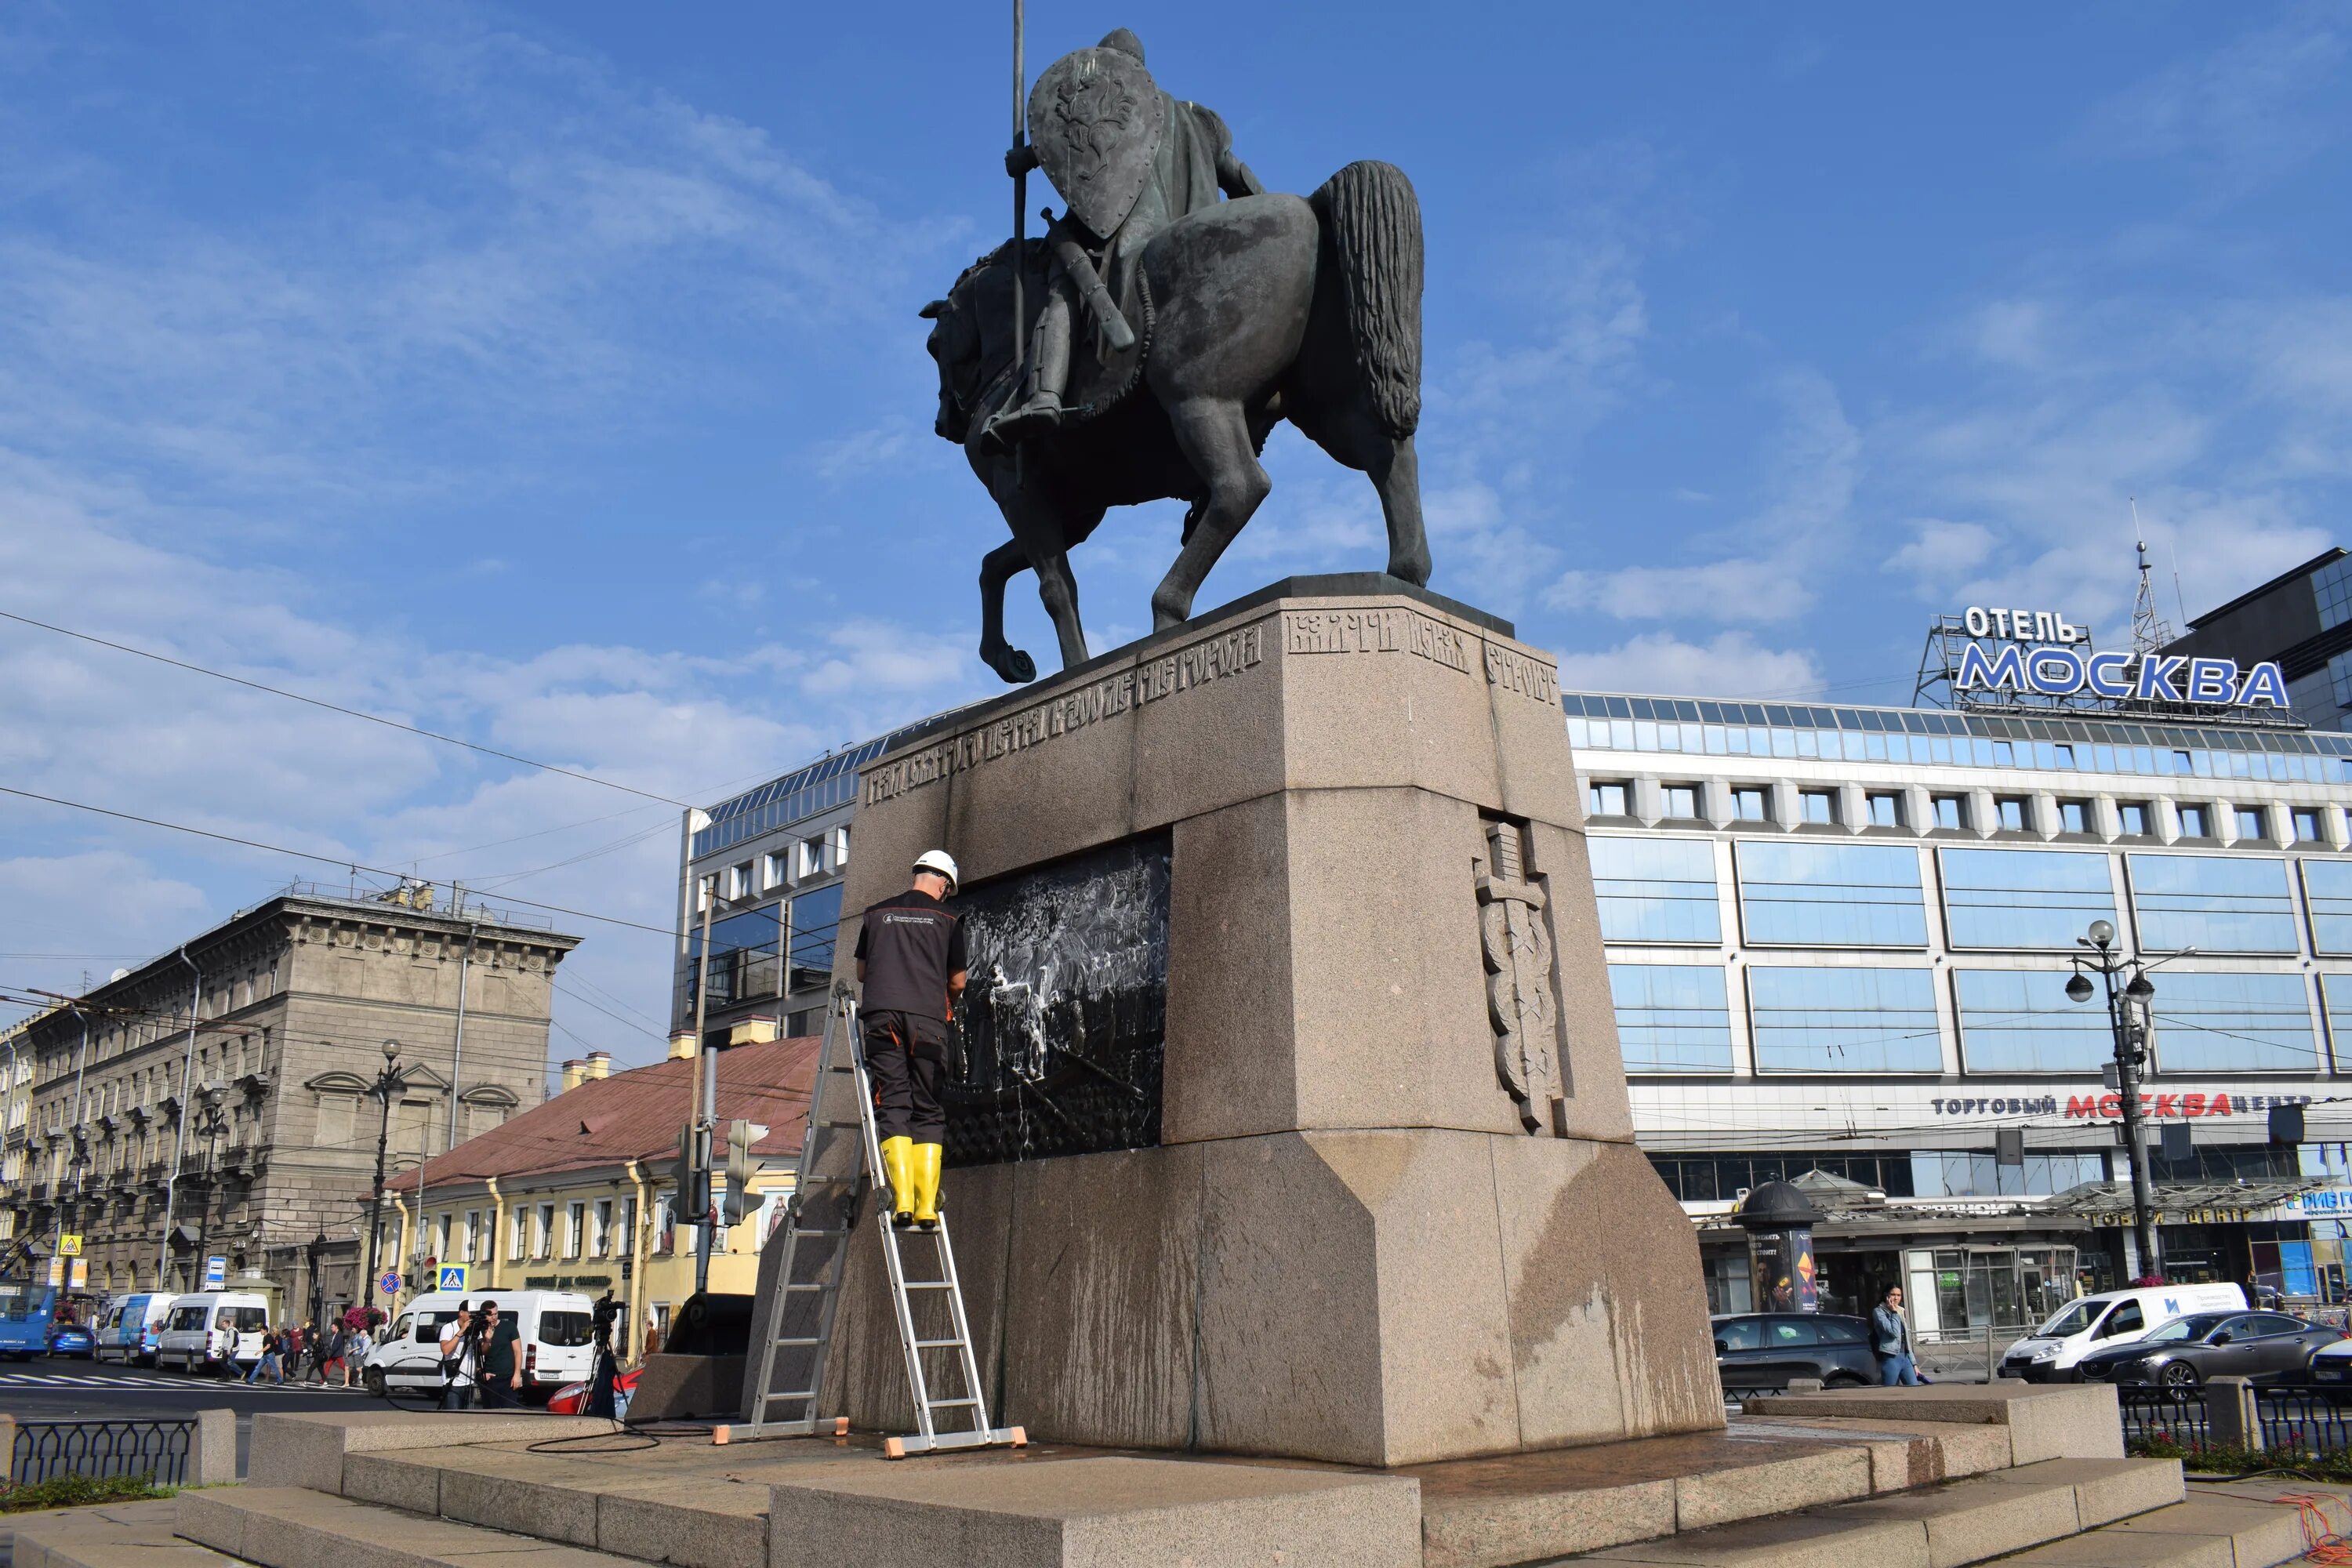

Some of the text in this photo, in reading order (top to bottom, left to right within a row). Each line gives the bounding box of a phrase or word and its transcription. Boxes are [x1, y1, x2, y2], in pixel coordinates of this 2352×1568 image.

[1963, 606, 2077, 644] ОТЕЛЬ
[1955, 641, 2291, 709] МОСКВА
[1931, 1095, 2056, 1115] ТОРГОВЫЙ
[2301, 1191, 2352, 1208] РИВ Г
[2187, 1208, 2252, 1224] ЦЕНТР
